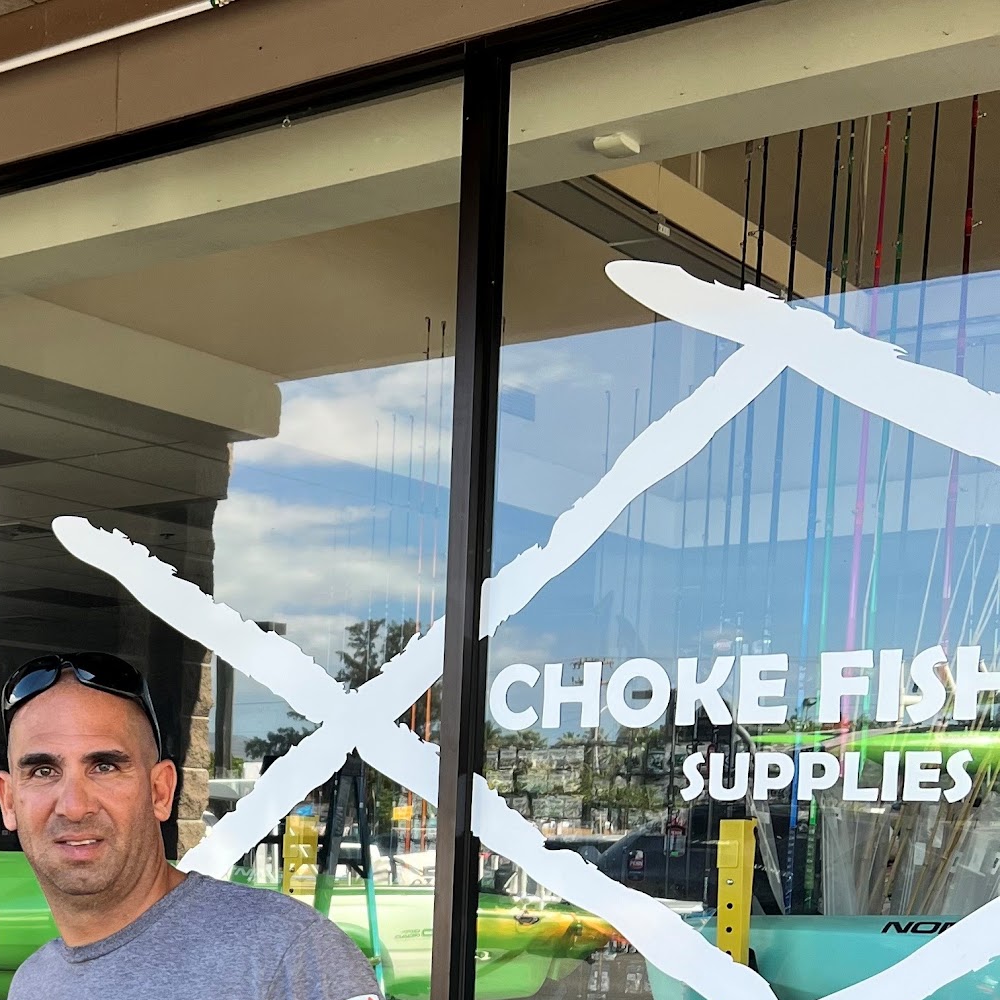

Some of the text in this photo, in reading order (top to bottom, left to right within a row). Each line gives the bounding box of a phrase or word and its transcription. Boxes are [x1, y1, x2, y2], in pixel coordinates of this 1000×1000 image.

[489, 645, 1000, 731] CHOKE FISH
[680, 749, 974, 804] SUPPLIES
